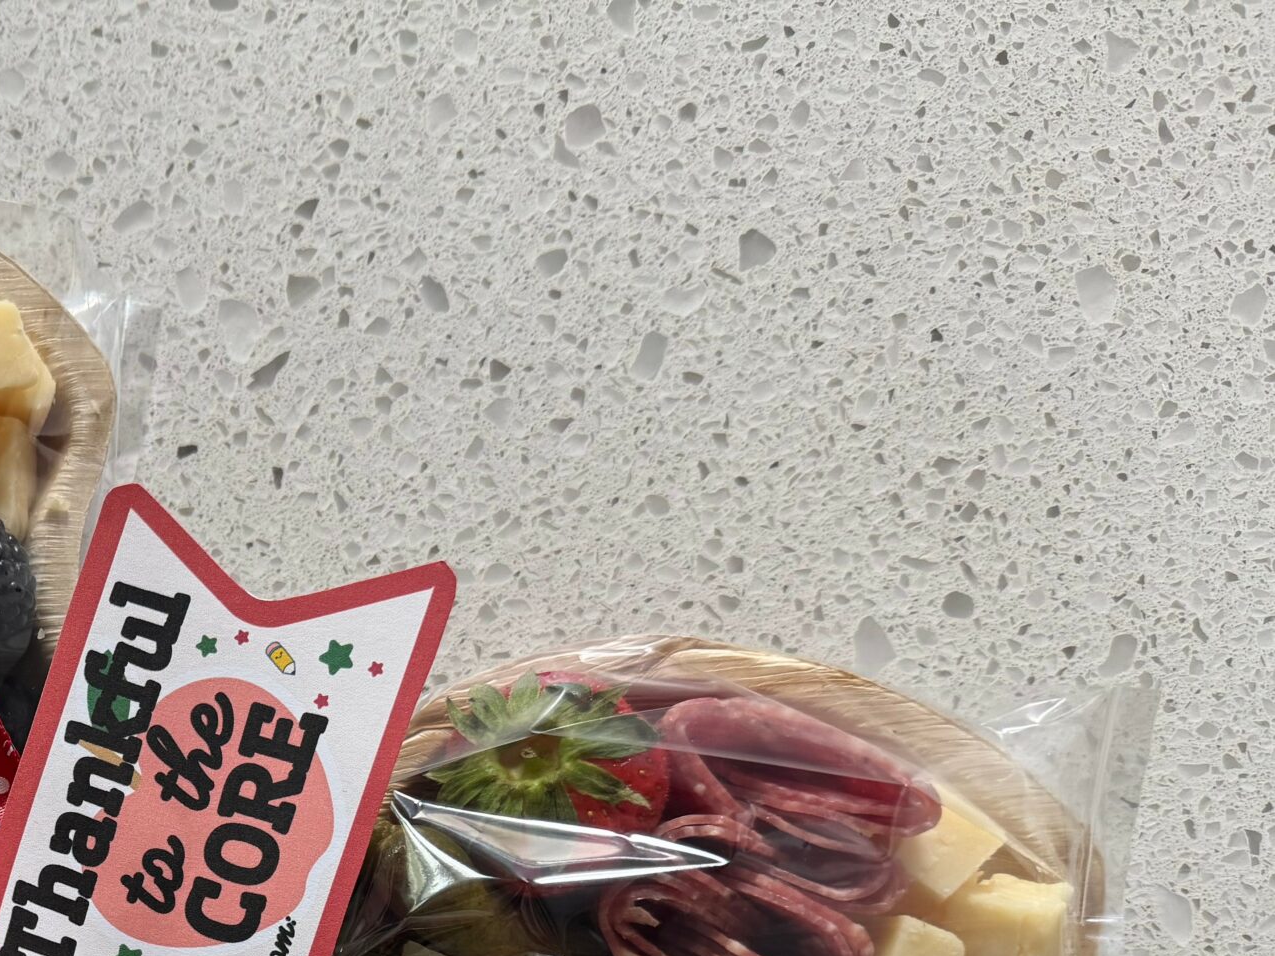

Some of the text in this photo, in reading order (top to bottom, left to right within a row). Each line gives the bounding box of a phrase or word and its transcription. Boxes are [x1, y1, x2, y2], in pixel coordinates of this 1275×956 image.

[121, 691, 235, 915] to the
[184, 701, 329, 944] CORE
